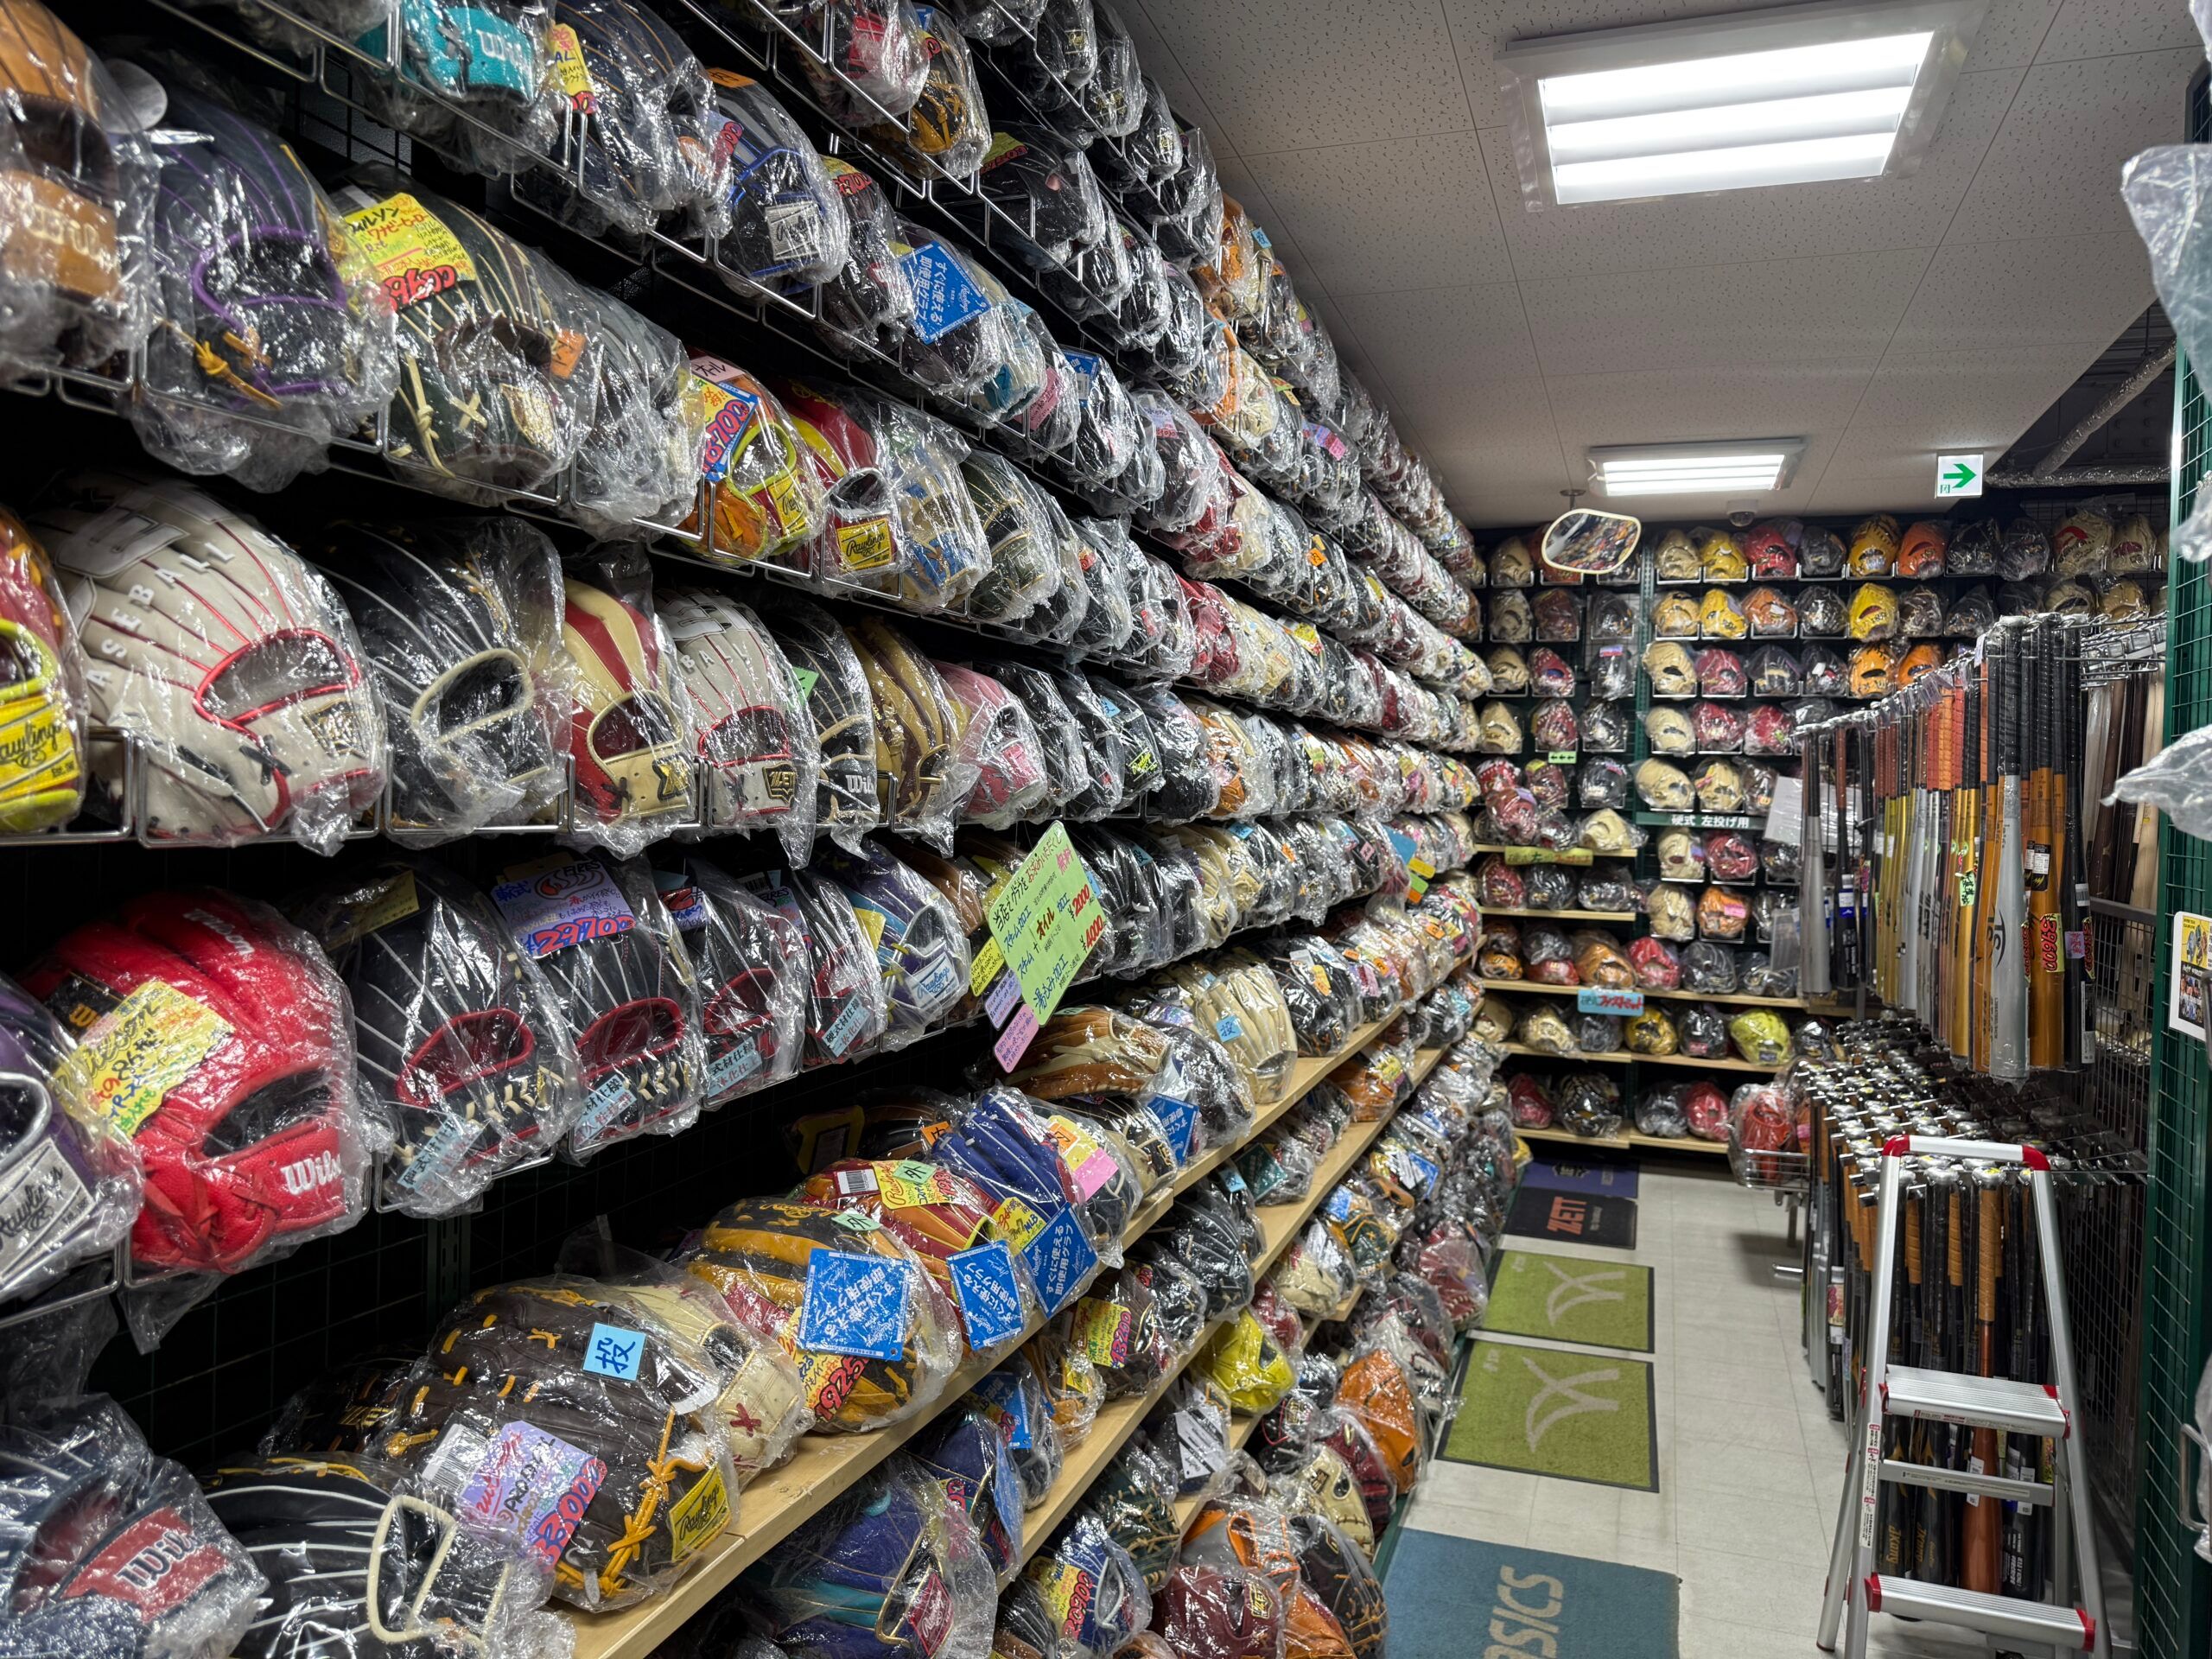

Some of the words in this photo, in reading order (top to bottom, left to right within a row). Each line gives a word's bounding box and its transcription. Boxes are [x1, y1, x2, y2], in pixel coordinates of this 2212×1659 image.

[916, 255, 933, 321] 即使用グラブ
[931, 261, 949, 327] すぐに使える
[846, 532, 886, 557] Rawlings
[1671, 814, 1695, 827] 硬式
[1700, 814, 1751, 829] 左投げ用
[1056, 844, 1074, 875] 無料
[1017, 950, 1034, 979] スチーム
[1036, 906, 1056, 940] オイル
[1056, 893, 1071, 912] 加工
[917, 965, 951, 999] Rawlings
[1546, 1195, 1587, 1236] ZETT
[1046, 1224, 1065, 1295] すぐに使える
[1054, 1223, 1074, 1295] 即使用グラブ
[963, 1262, 1017, 1312] 即使用グラブ
[594, 1336, 637, 1375] 投
[815, 1356, 871, 1421] 1925
[678, 1484, 721, 1541] Rawlings
